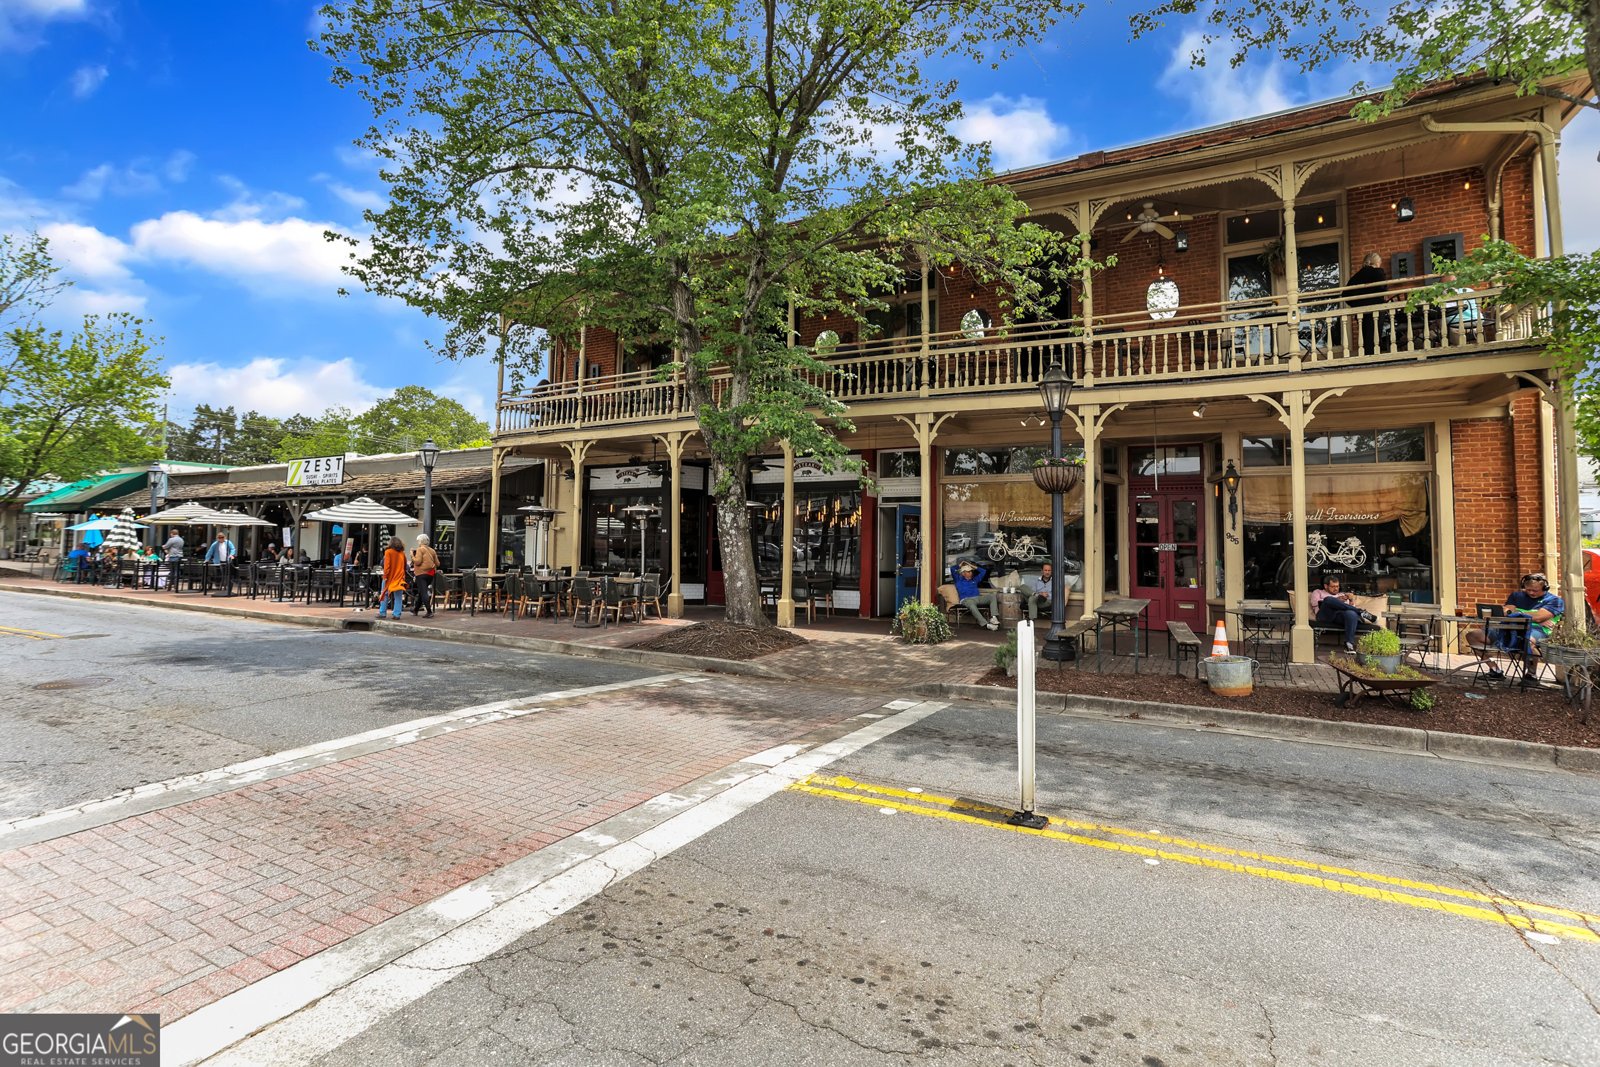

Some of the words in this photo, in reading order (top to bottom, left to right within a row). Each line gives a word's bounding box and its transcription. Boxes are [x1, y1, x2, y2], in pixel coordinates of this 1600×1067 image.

[304, 458, 342, 472] ZEST
[1326, 507, 1380, 520] Provisions
[1226, 532, 1239, 545] 955
[1159, 543, 1177, 551] OPEN
